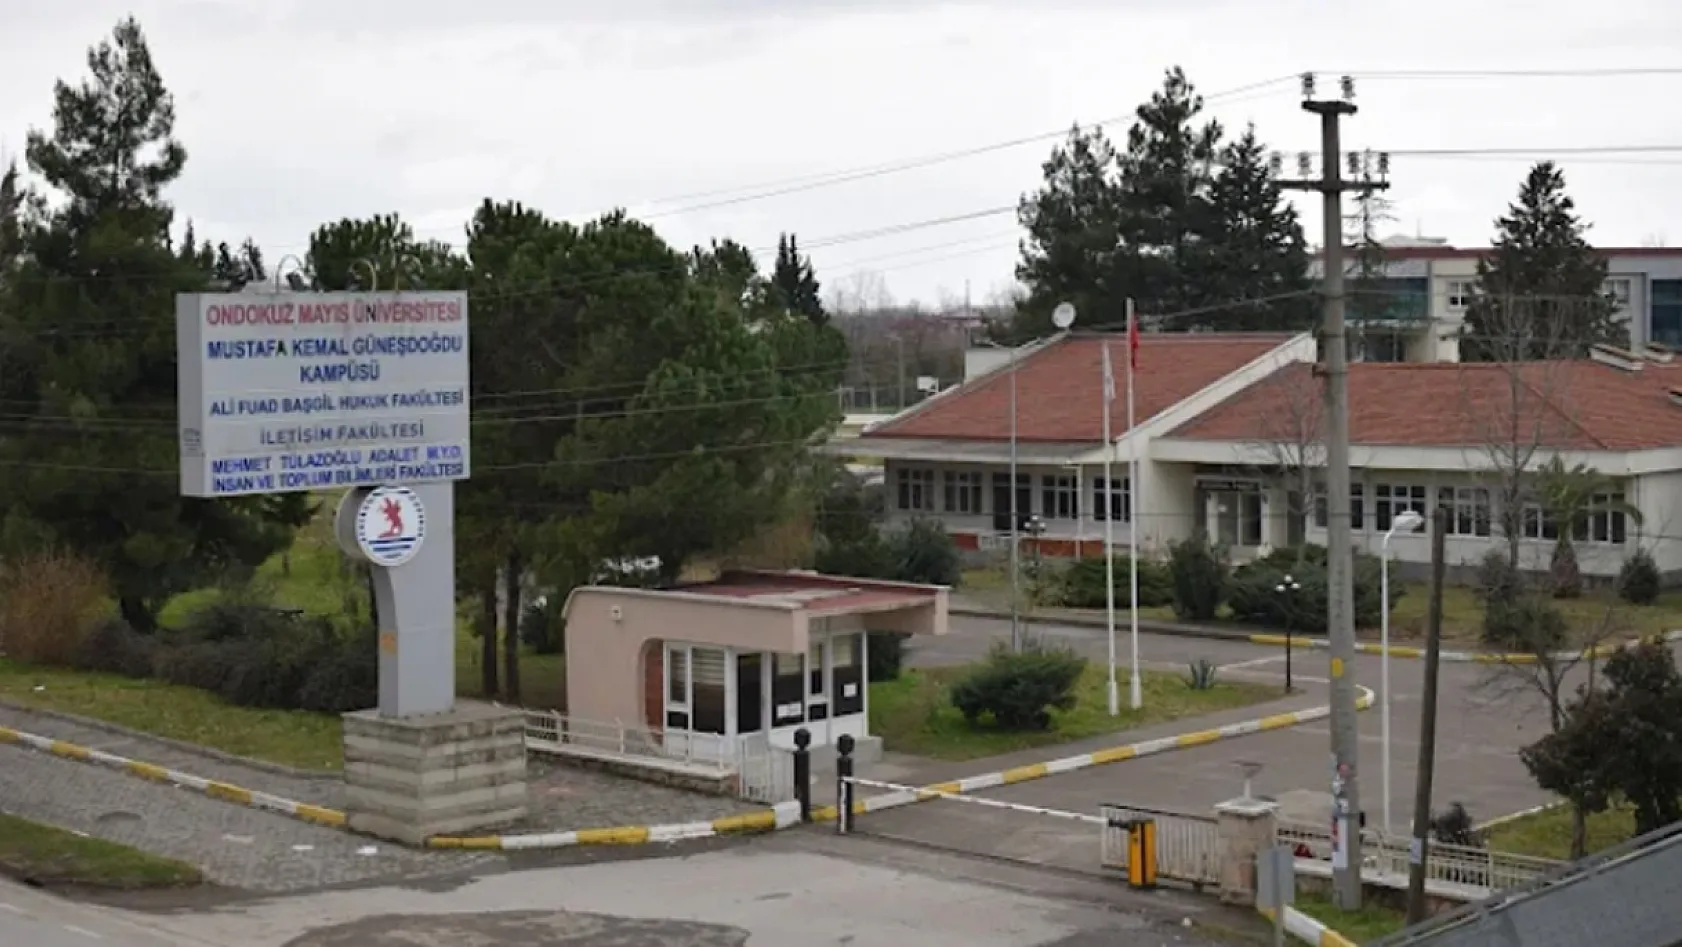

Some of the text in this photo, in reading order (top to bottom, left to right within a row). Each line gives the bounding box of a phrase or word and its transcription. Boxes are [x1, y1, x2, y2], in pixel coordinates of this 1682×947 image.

[206, 298, 462, 326] ONDOKUZ MAYIS ÜNİVERSİTESİ
[208, 331, 463, 359] MUSTAFA KEMAL GÜNEŞDOĞDU
[300, 361, 380, 382] KAMPÜSÜ
[210, 397, 235, 416] ALİ
[238, 398, 278, 415] FUAD
[282, 393, 336, 414] BAŞGİL
[391, 388, 464, 407] FAKÜLTESİ
[260, 418, 424, 445] İLETİŞİM FAKÜLTESİ
[212, 456, 271, 474] MEHMET
